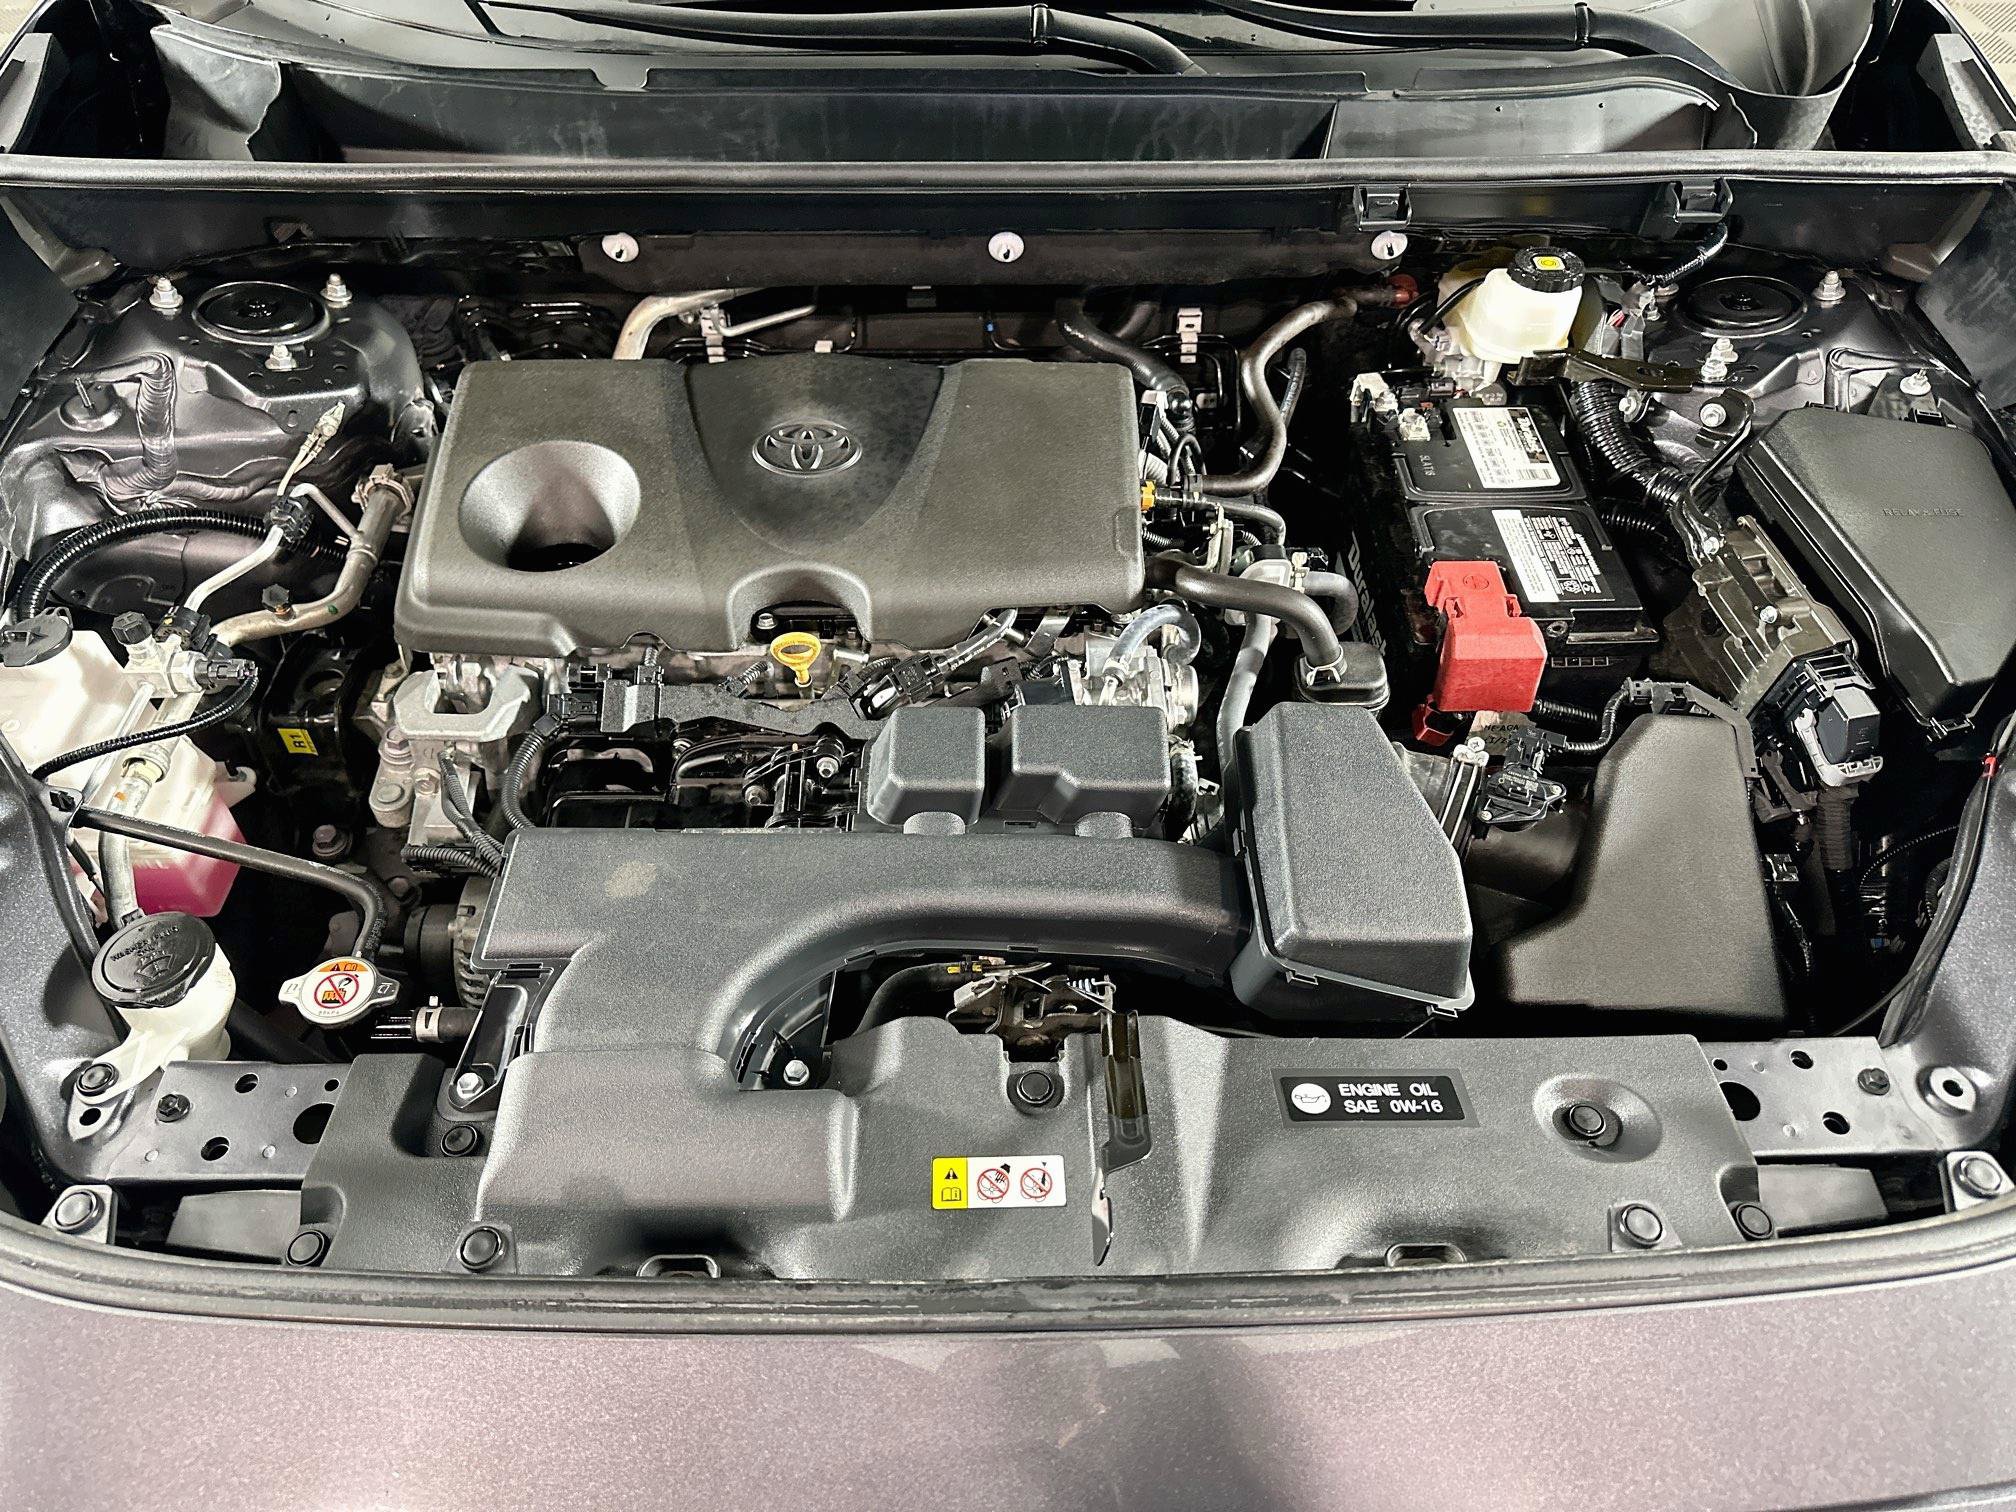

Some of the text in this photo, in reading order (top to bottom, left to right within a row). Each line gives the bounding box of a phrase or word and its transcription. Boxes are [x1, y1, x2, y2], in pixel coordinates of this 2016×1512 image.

[1338, 1083, 1438, 1097] ENGINE OIL
[1344, 1099, 1444, 1113] SAE 0W-16
